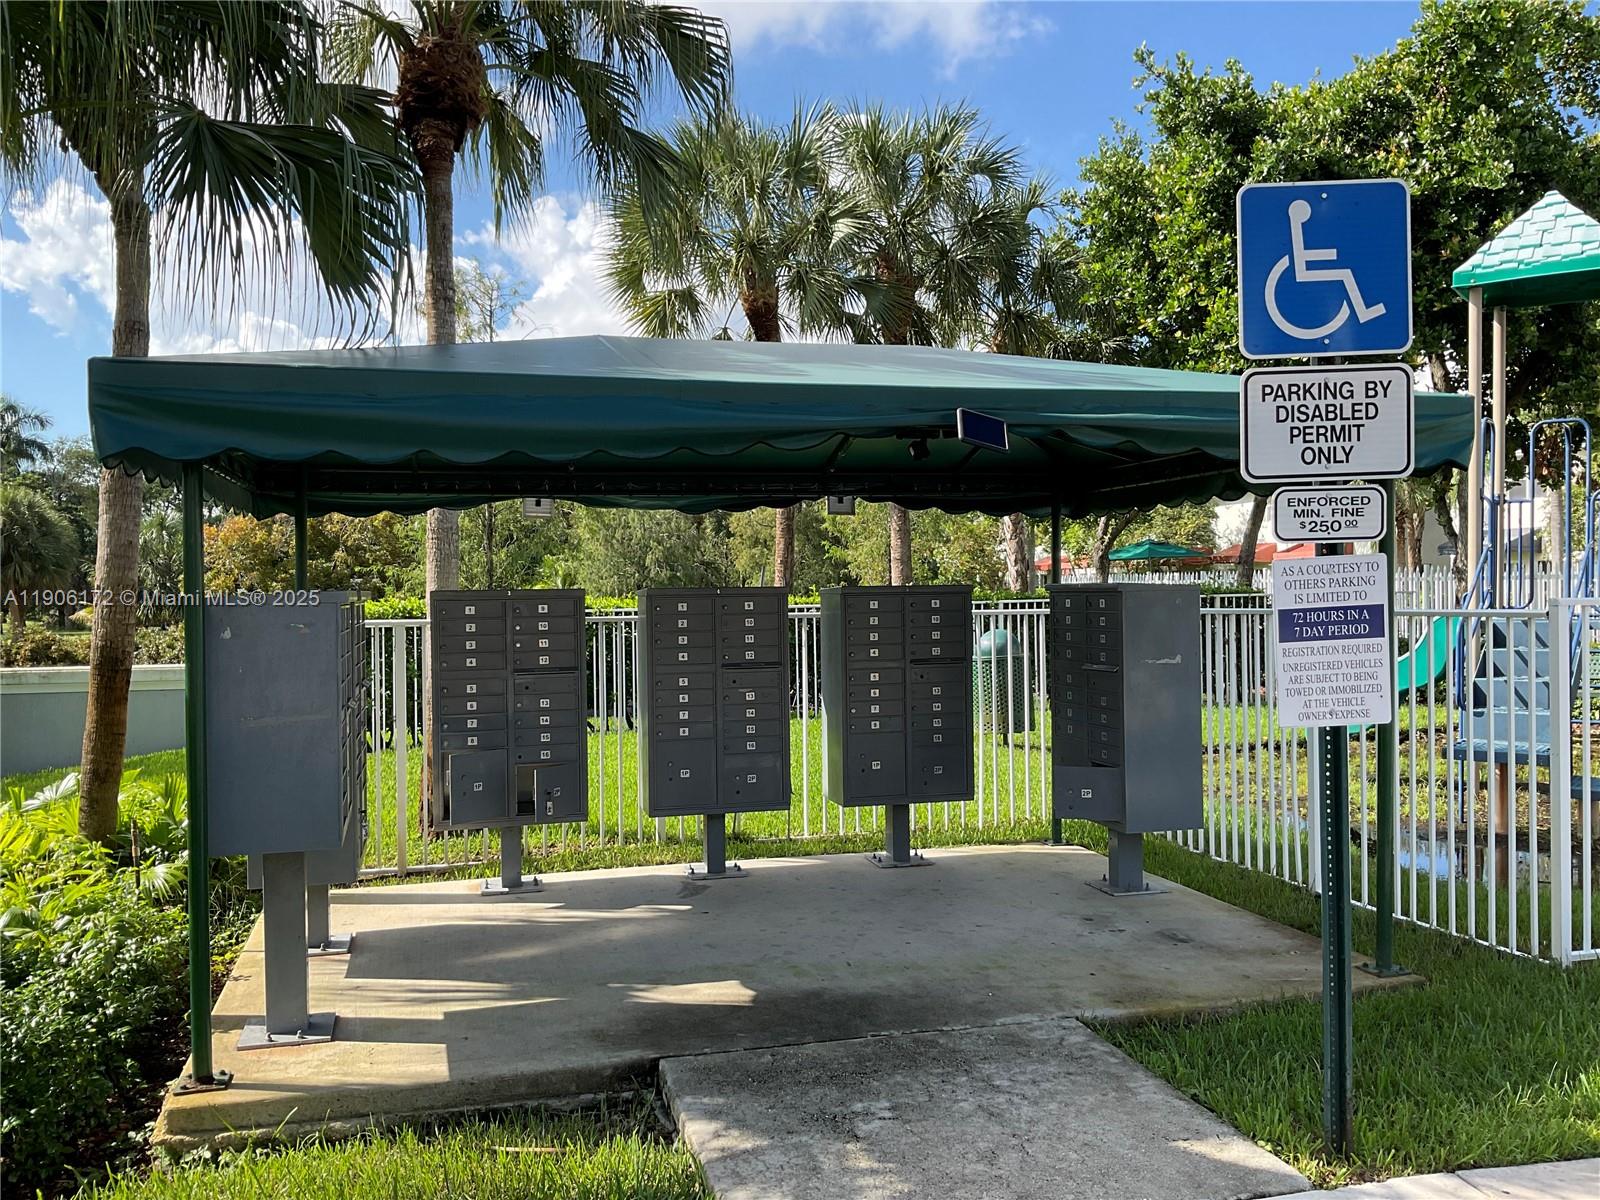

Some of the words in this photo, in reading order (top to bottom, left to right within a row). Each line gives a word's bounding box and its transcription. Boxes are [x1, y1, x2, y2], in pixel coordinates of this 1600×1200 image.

[1262, 381, 1354, 402] PARKING
[1364, 380, 1392, 398] BY
[1276, 402, 1378, 423] DISABLED
[1290, 424, 1365, 444] PERMIT
[1301, 446, 1354, 465] ONLY
[1287, 496, 1371, 507] ENFORCED
[1293, 508, 1324, 519] MIN.
[1332, 507, 1365, 517] FINE
[1281, 566, 1294, 577] AS
[1296, 566, 1304, 576] A
[1307, 562, 1364, 575] COURTESY
[1365, 561, 1379, 572] TO
[1284, 579, 1326, 590] OTHERS
[1329, 576, 1376, 588] PARKING
[1294, 594, 1304, 604] IS
[1306, 591, 1350, 604] LIMITED
[1353, 590, 1367, 600] TO
[1293, 612, 1304, 623] 72
[1307, 610, 1344, 622] HOURS
[1347, 610, 1359, 620] IN
[1361, 609, 1370, 619] A
[1294, 627, 1300, 637] 7
[1303, 626, 1326, 637] DAY
[1328, 624, 1369, 636] PERIOD
[1282, 645, 1340, 658] REGISTRATION
[1342, 643, 1382, 655] REQUIRED
[1283, 660, 1343, 673] UNREGISTERED
[1345, 658, 1383, 669] VEHICLES
[1288, 675, 1304, 685] ARE
[1306, 673, 1340, 684] SUBJECT
[1341, 672, 1352, 682] TO
[1354, 671, 1378, 681] BEING
[1285, 688, 1314, 698] TOWED
[1315, 687, 1327, 696] OR
[1328, 684, 1382, 695] IMMOBILIZED
[1302, 700, 1314, 709] AT
[1315, 699, 1330, 708] THE
[1331, 697, 1366, 707] VEHICLE
[1298, 711, 1333, 721] OWNER'S
[1335, 709, 1370, 719] EXPENSE
